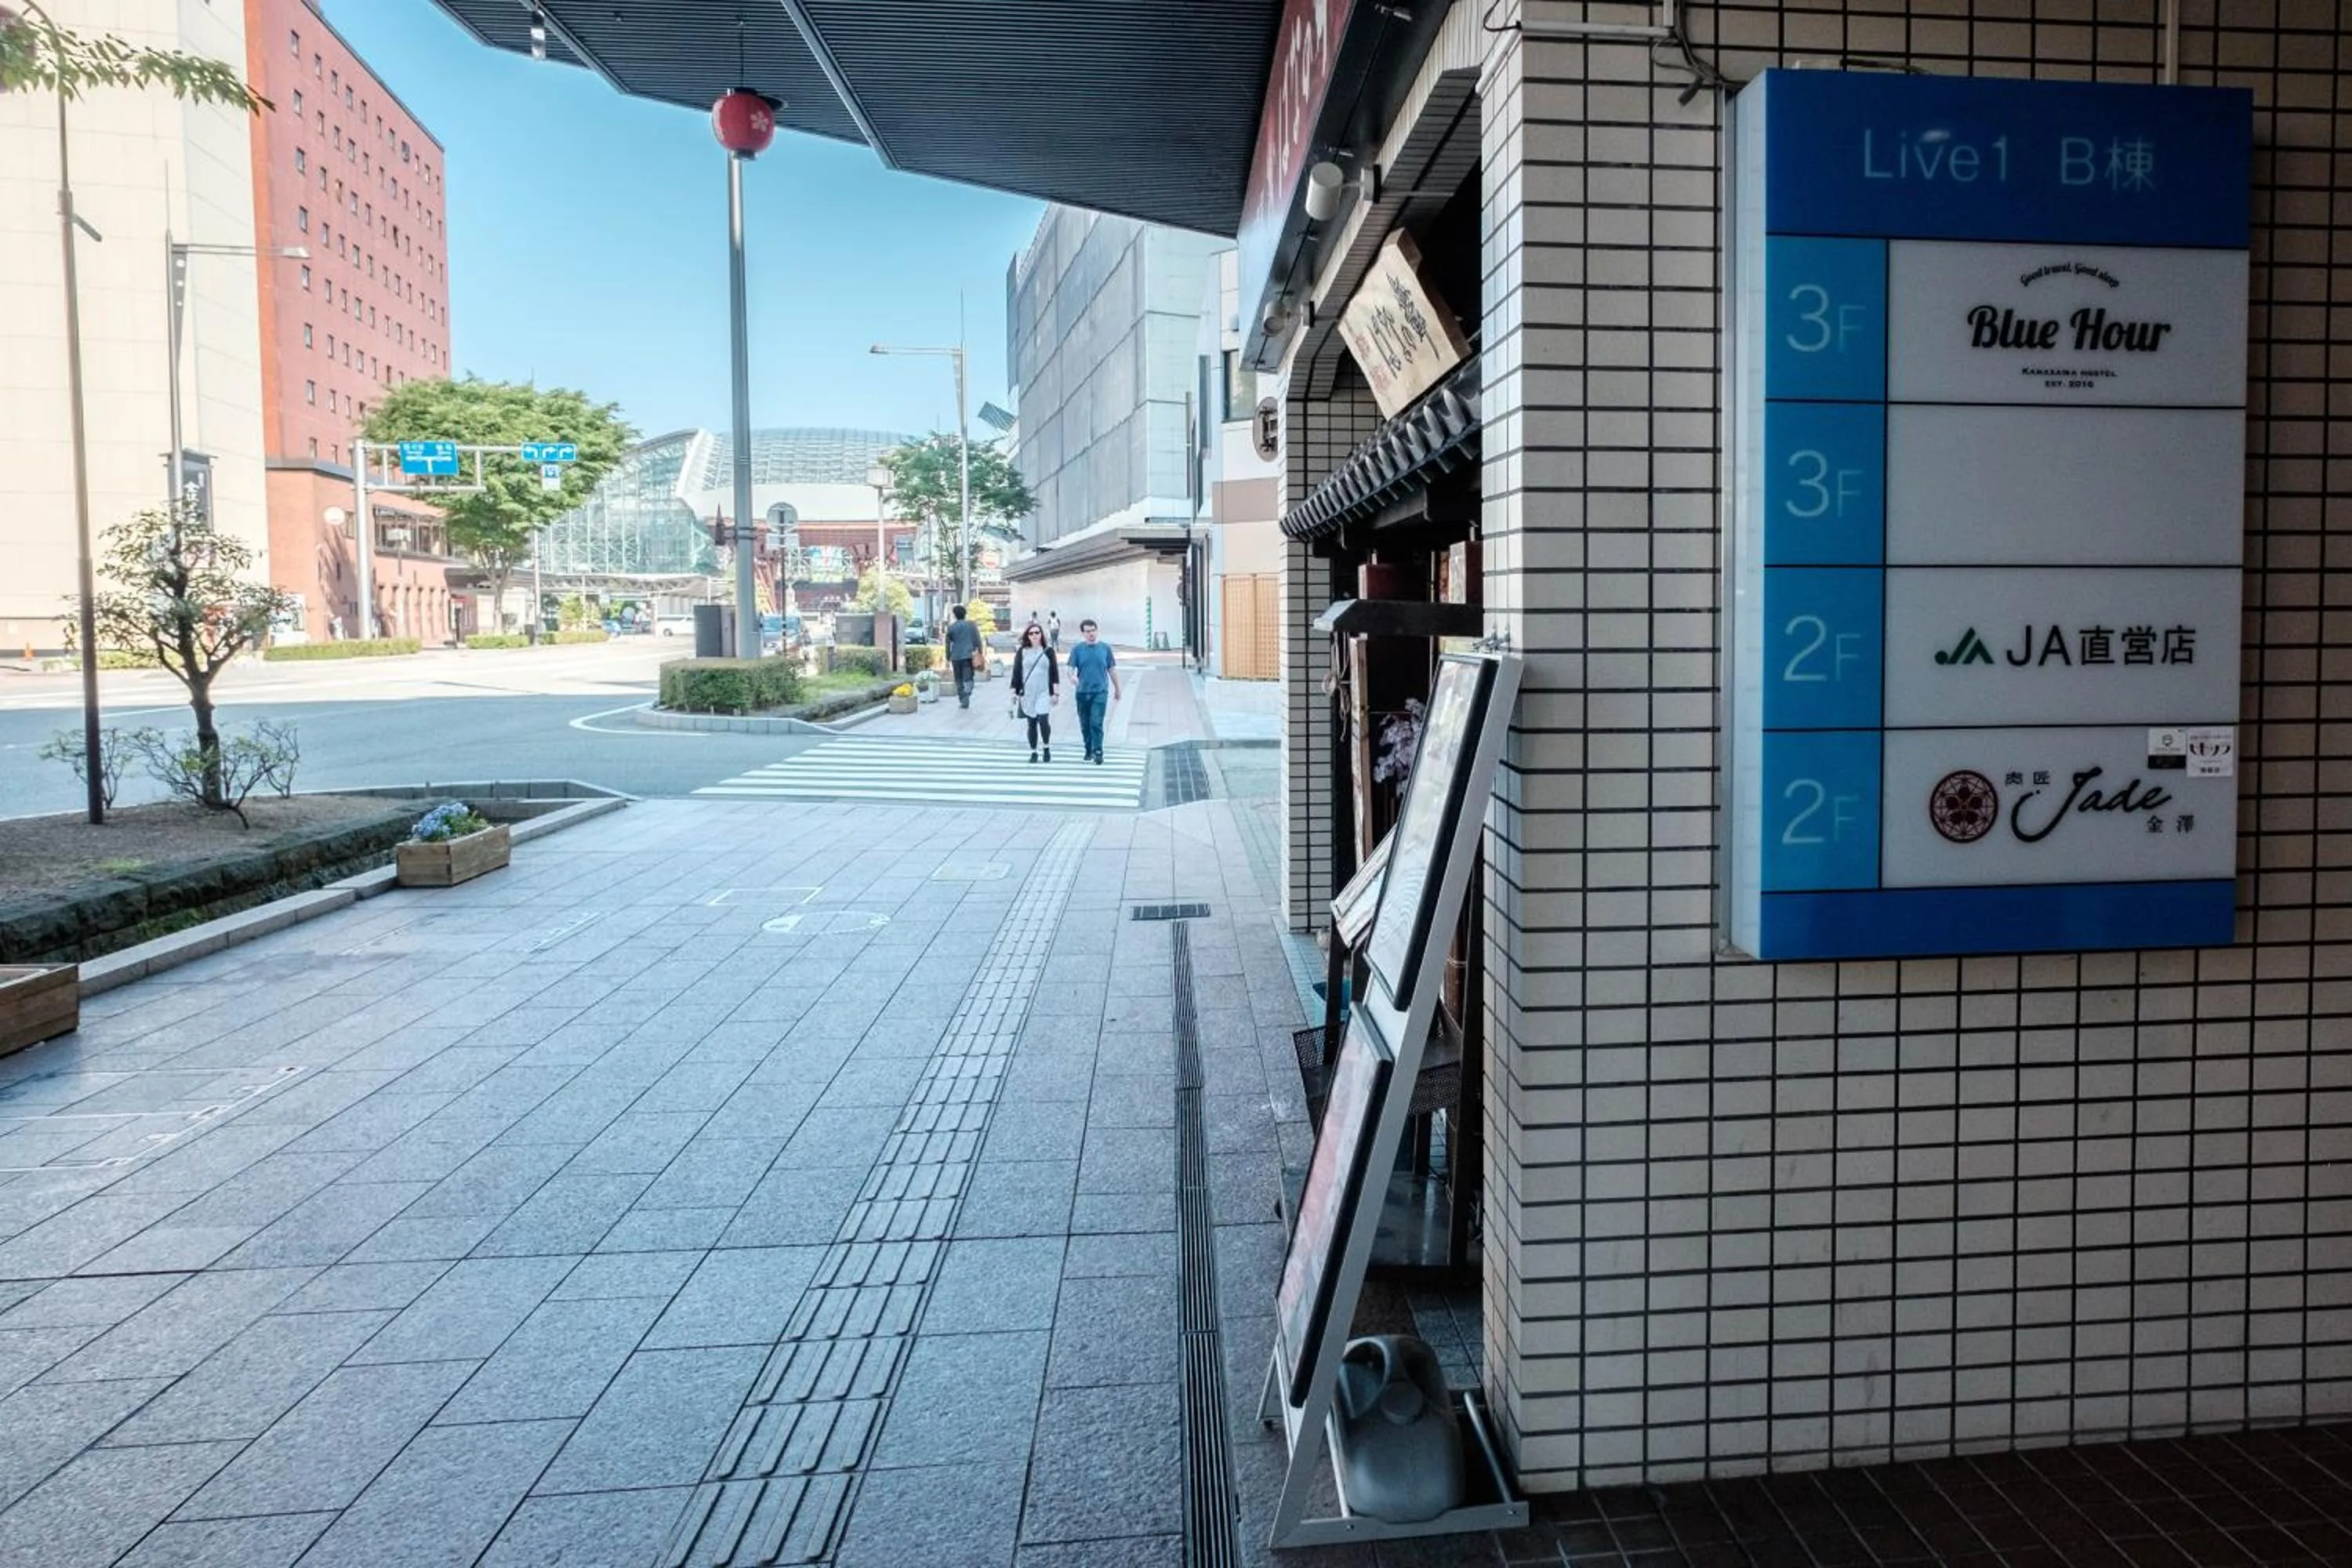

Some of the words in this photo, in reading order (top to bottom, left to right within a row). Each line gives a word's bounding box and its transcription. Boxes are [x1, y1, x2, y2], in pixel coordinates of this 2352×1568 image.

[1863, 129, 2008, 183] Live1
[2060, 136, 2158, 192] B棟
[1785, 284, 1866, 353] 3F
[1967, 305, 2060, 350] Blue
[2069, 307, 2172, 352] Hour
[2068, 379, 2094, 388] 2016
[1785, 449, 1863, 518] 3F
[1783, 615, 1861, 682] 2F
[2006, 625, 2197, 666] JA直営店
[1781, 779, 1859, 845] 2F
[2010, 766, 2173, 844] Jade
